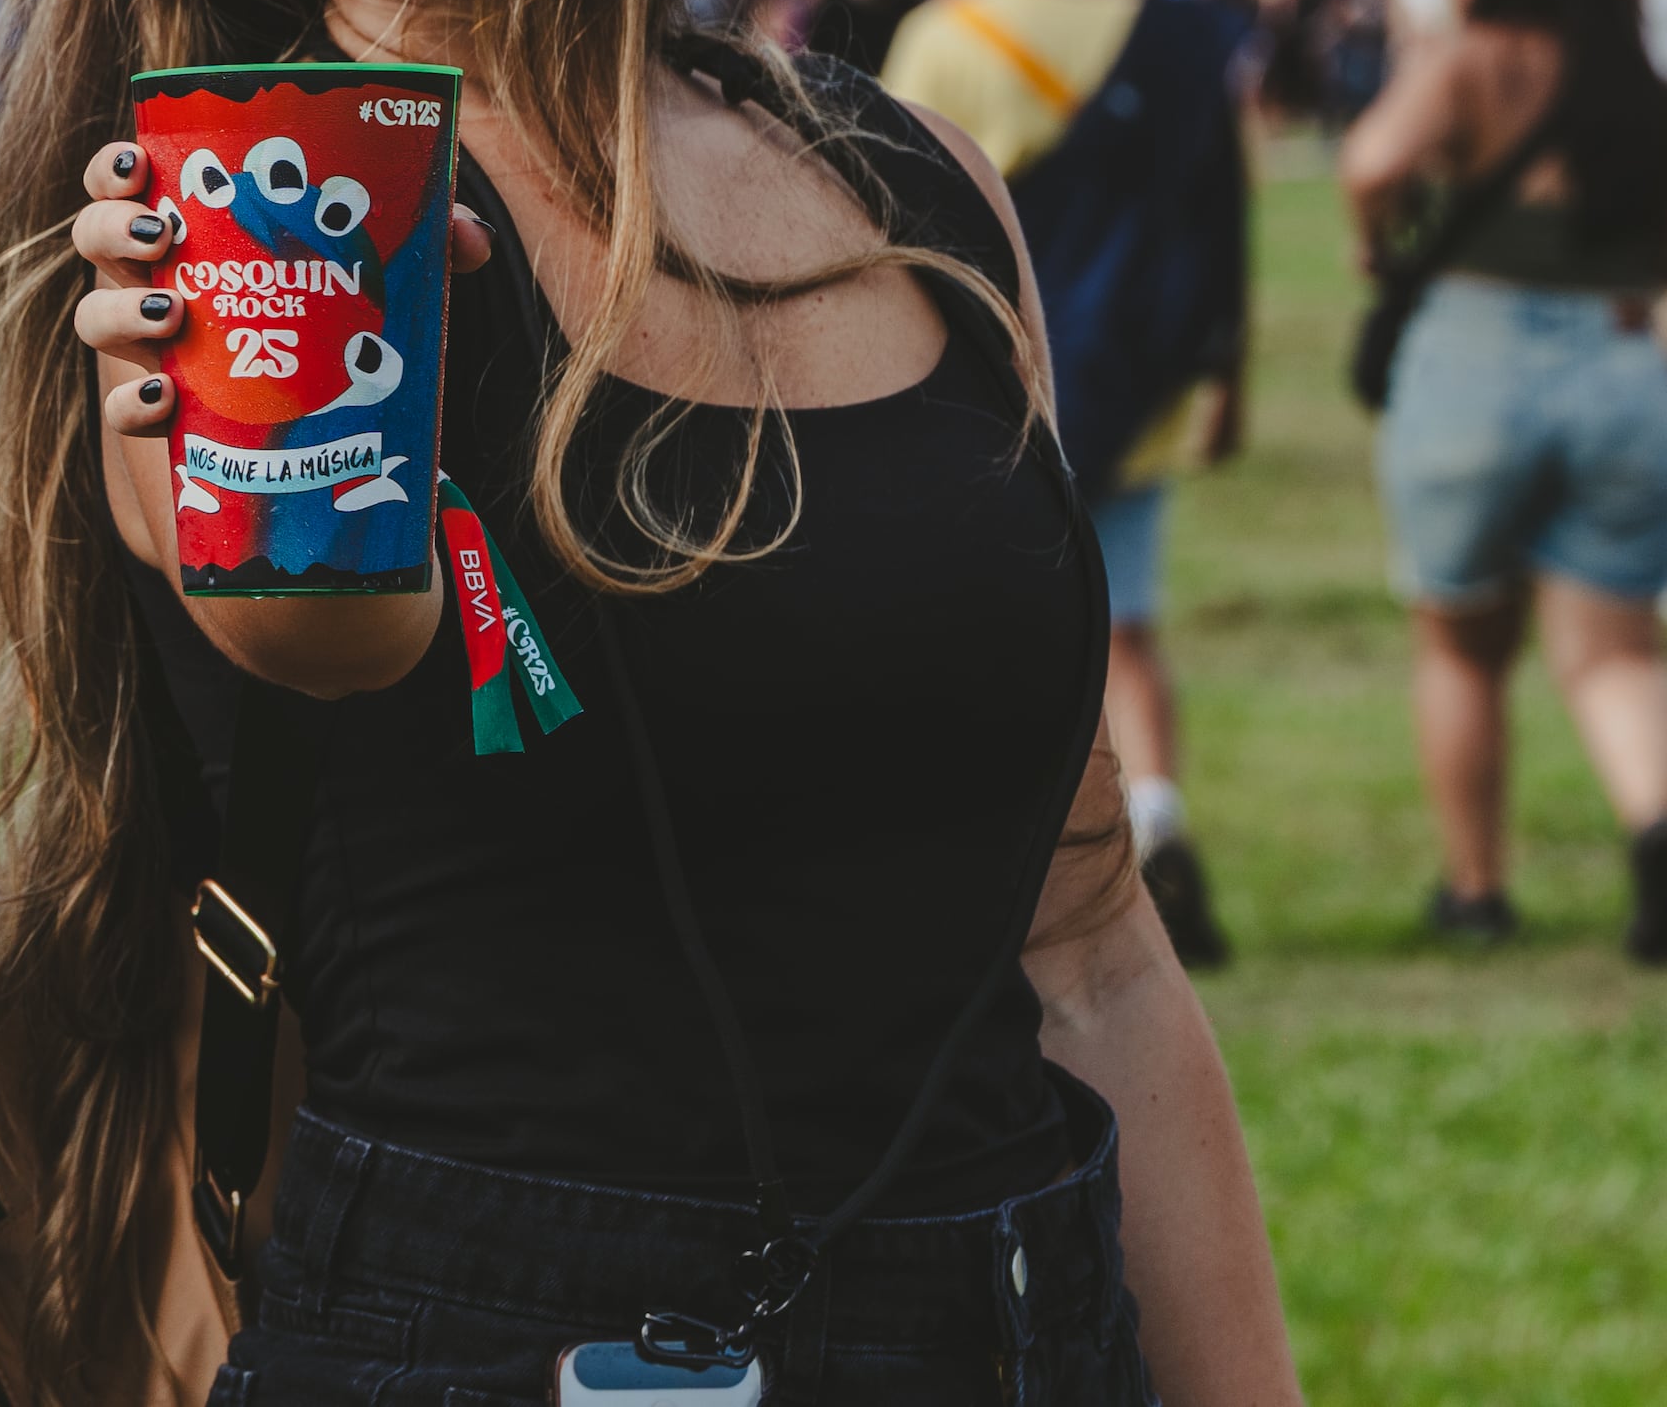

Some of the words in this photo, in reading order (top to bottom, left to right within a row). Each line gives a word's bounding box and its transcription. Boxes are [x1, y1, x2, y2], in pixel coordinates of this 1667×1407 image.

[359, 98, 441, 127] #CR25
[175, 260, 363, 300] COSQUIN
[213, 294, 306, 318] ROCK
[226, 327, 299, 378] 25
[190, 444, 217, 470] NOS
[221, 456, 258, 482] UNE
[265, 458, 292, 482] LA
[301, 446, 374, 480] MÚSICA
[459, 549, 497, 633] BBVA
[501, 605, 555, 696] #CR25
